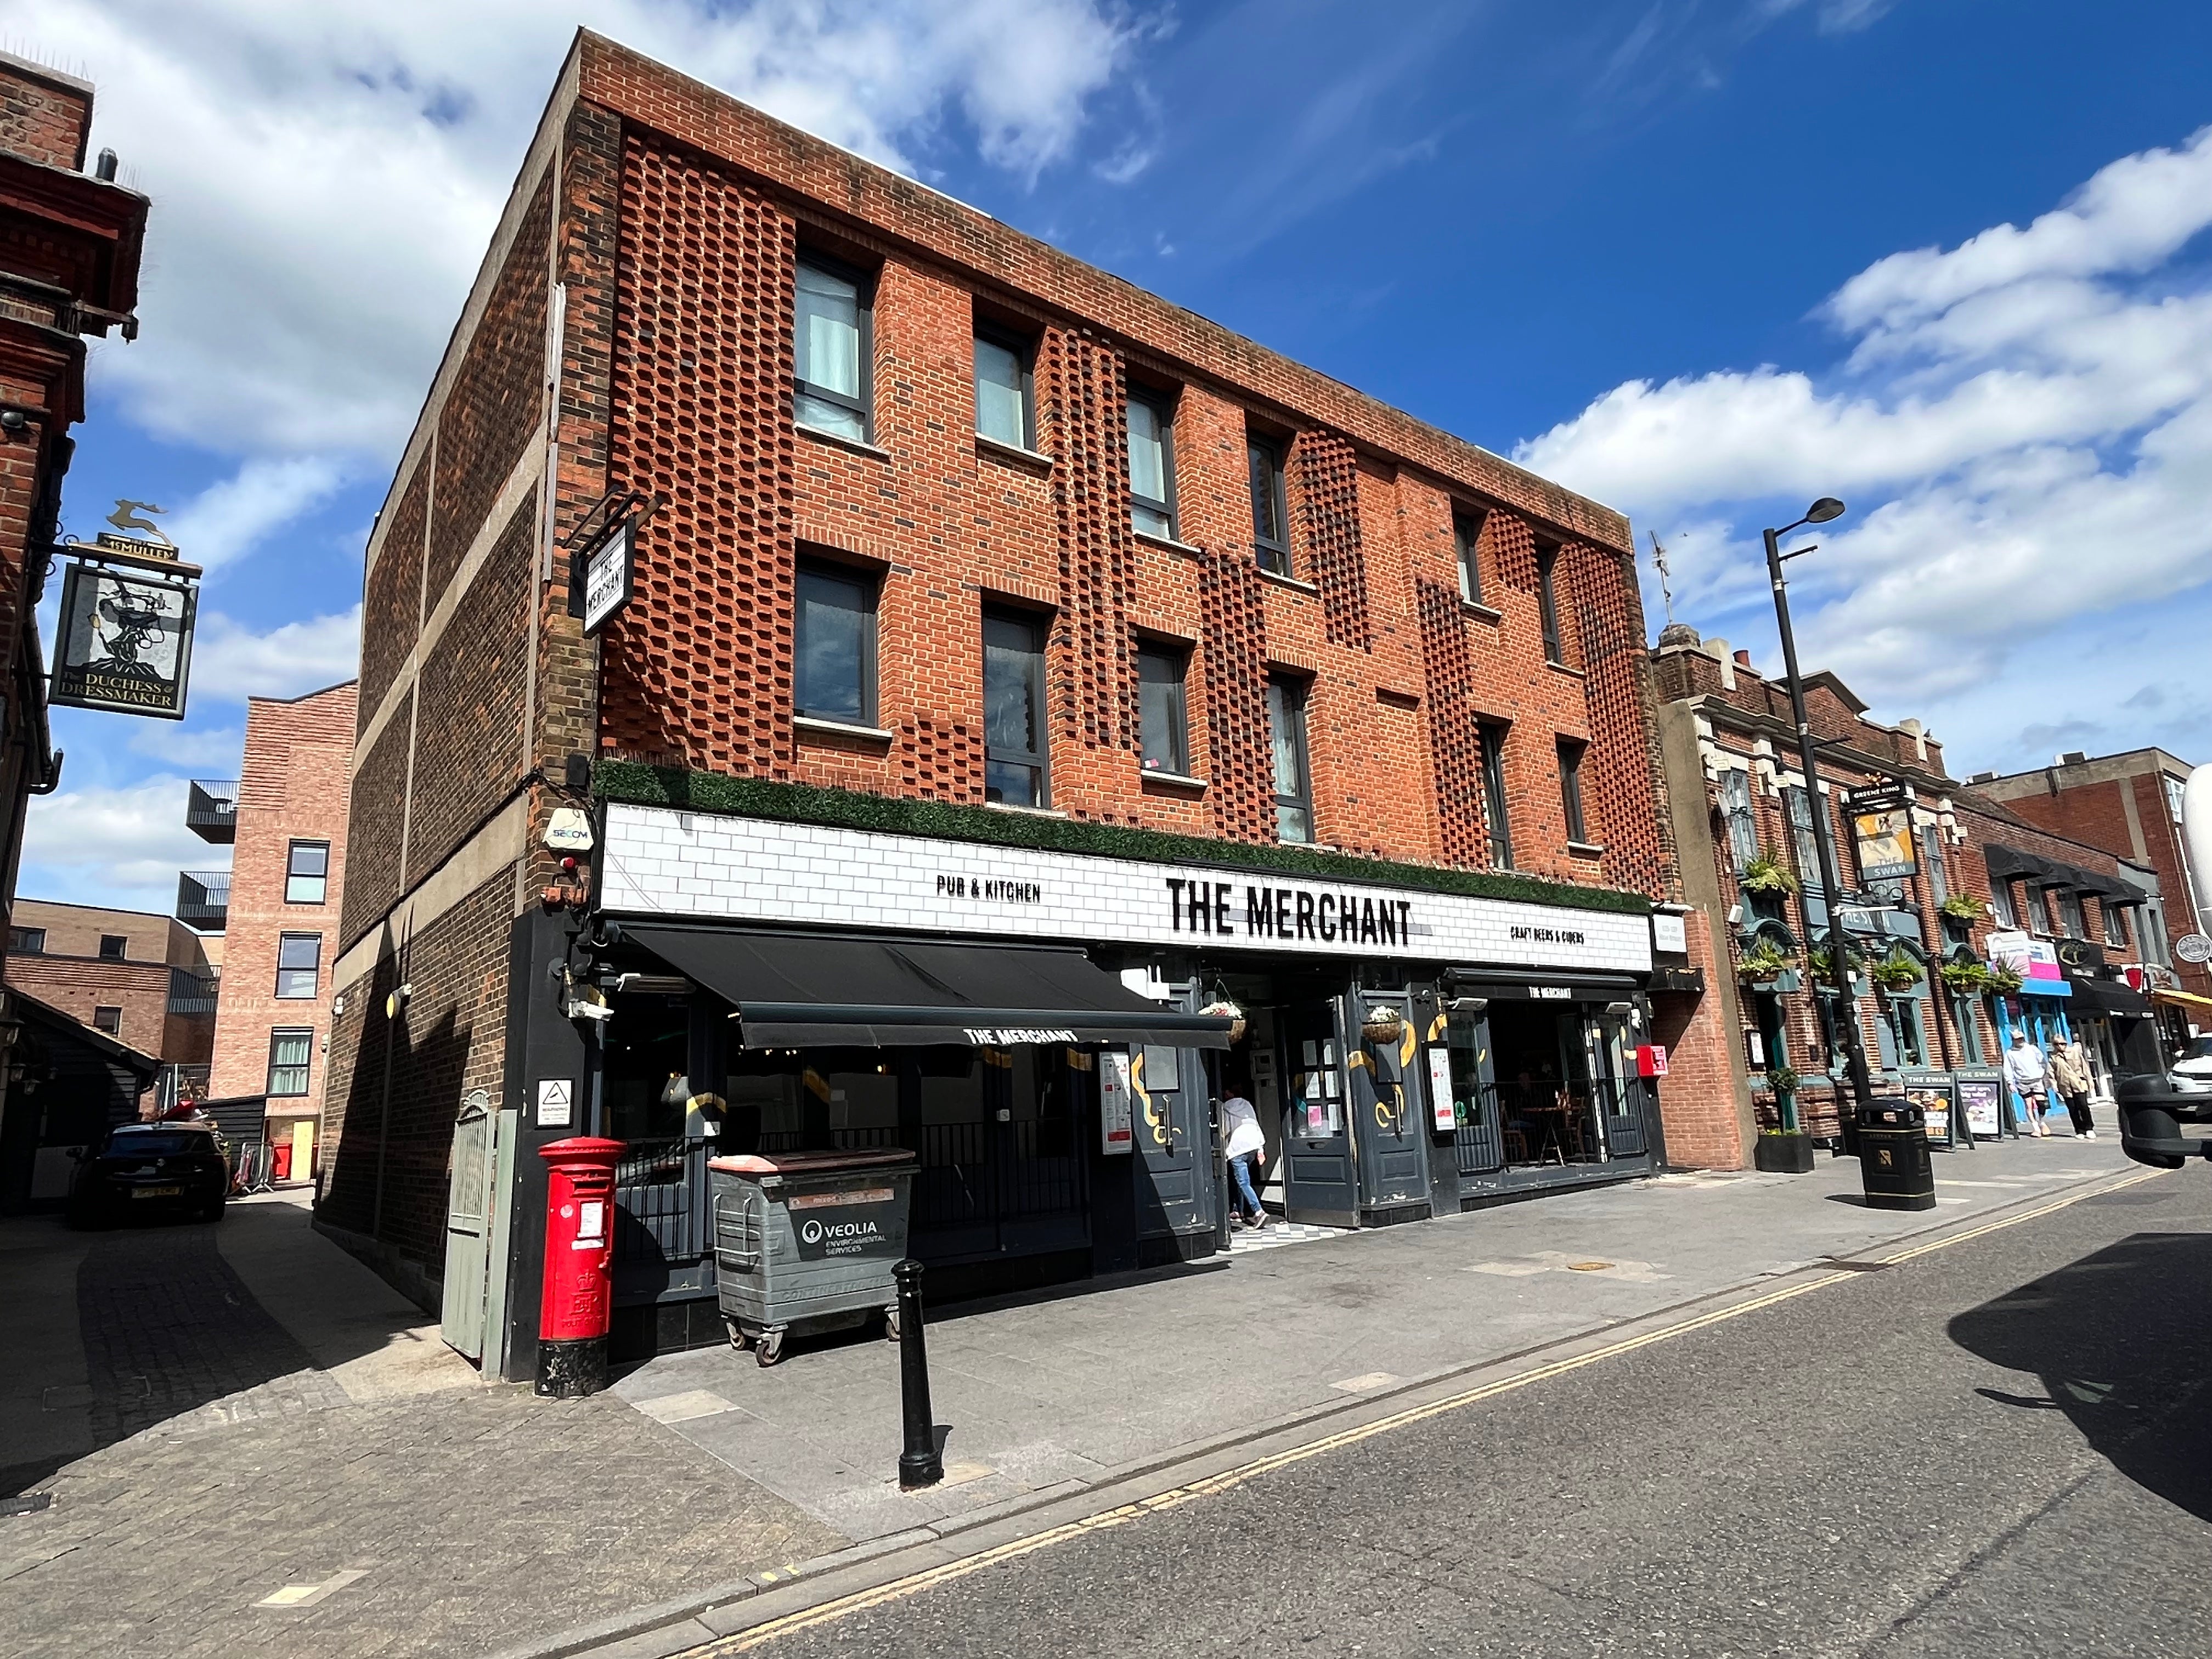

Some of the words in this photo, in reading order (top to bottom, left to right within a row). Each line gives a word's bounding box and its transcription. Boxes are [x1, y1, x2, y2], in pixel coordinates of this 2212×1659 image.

[86, 673, 161, 693] DUCHESS
[60, 681, 172, 707] DRESSMAKER
[1881, 785, 1900, 793] KING
[553, 830, 588, 839] SECOM
[1878, 856, 1899, 865] THE
[1874, 865, 1906, 877] SWAN
[936, 874, 965, 898] PUB
[970, 878, 980, 899] &
[985, 879, 1041, 904] KITCHEN
[1166, 878, 1233, 935] THE
[1246, 886, 1411, 947] MERCHANT
[963, 1029, 997, 1045] THE
[996, 1029, 1079, 1045] MERCHANT
[825, 1221, 877, 1238] VEOLIA
[826, 1234, 887, 1248] ENVIRONMENTAL
[826, 1245, 862, 1256] SERVICES
